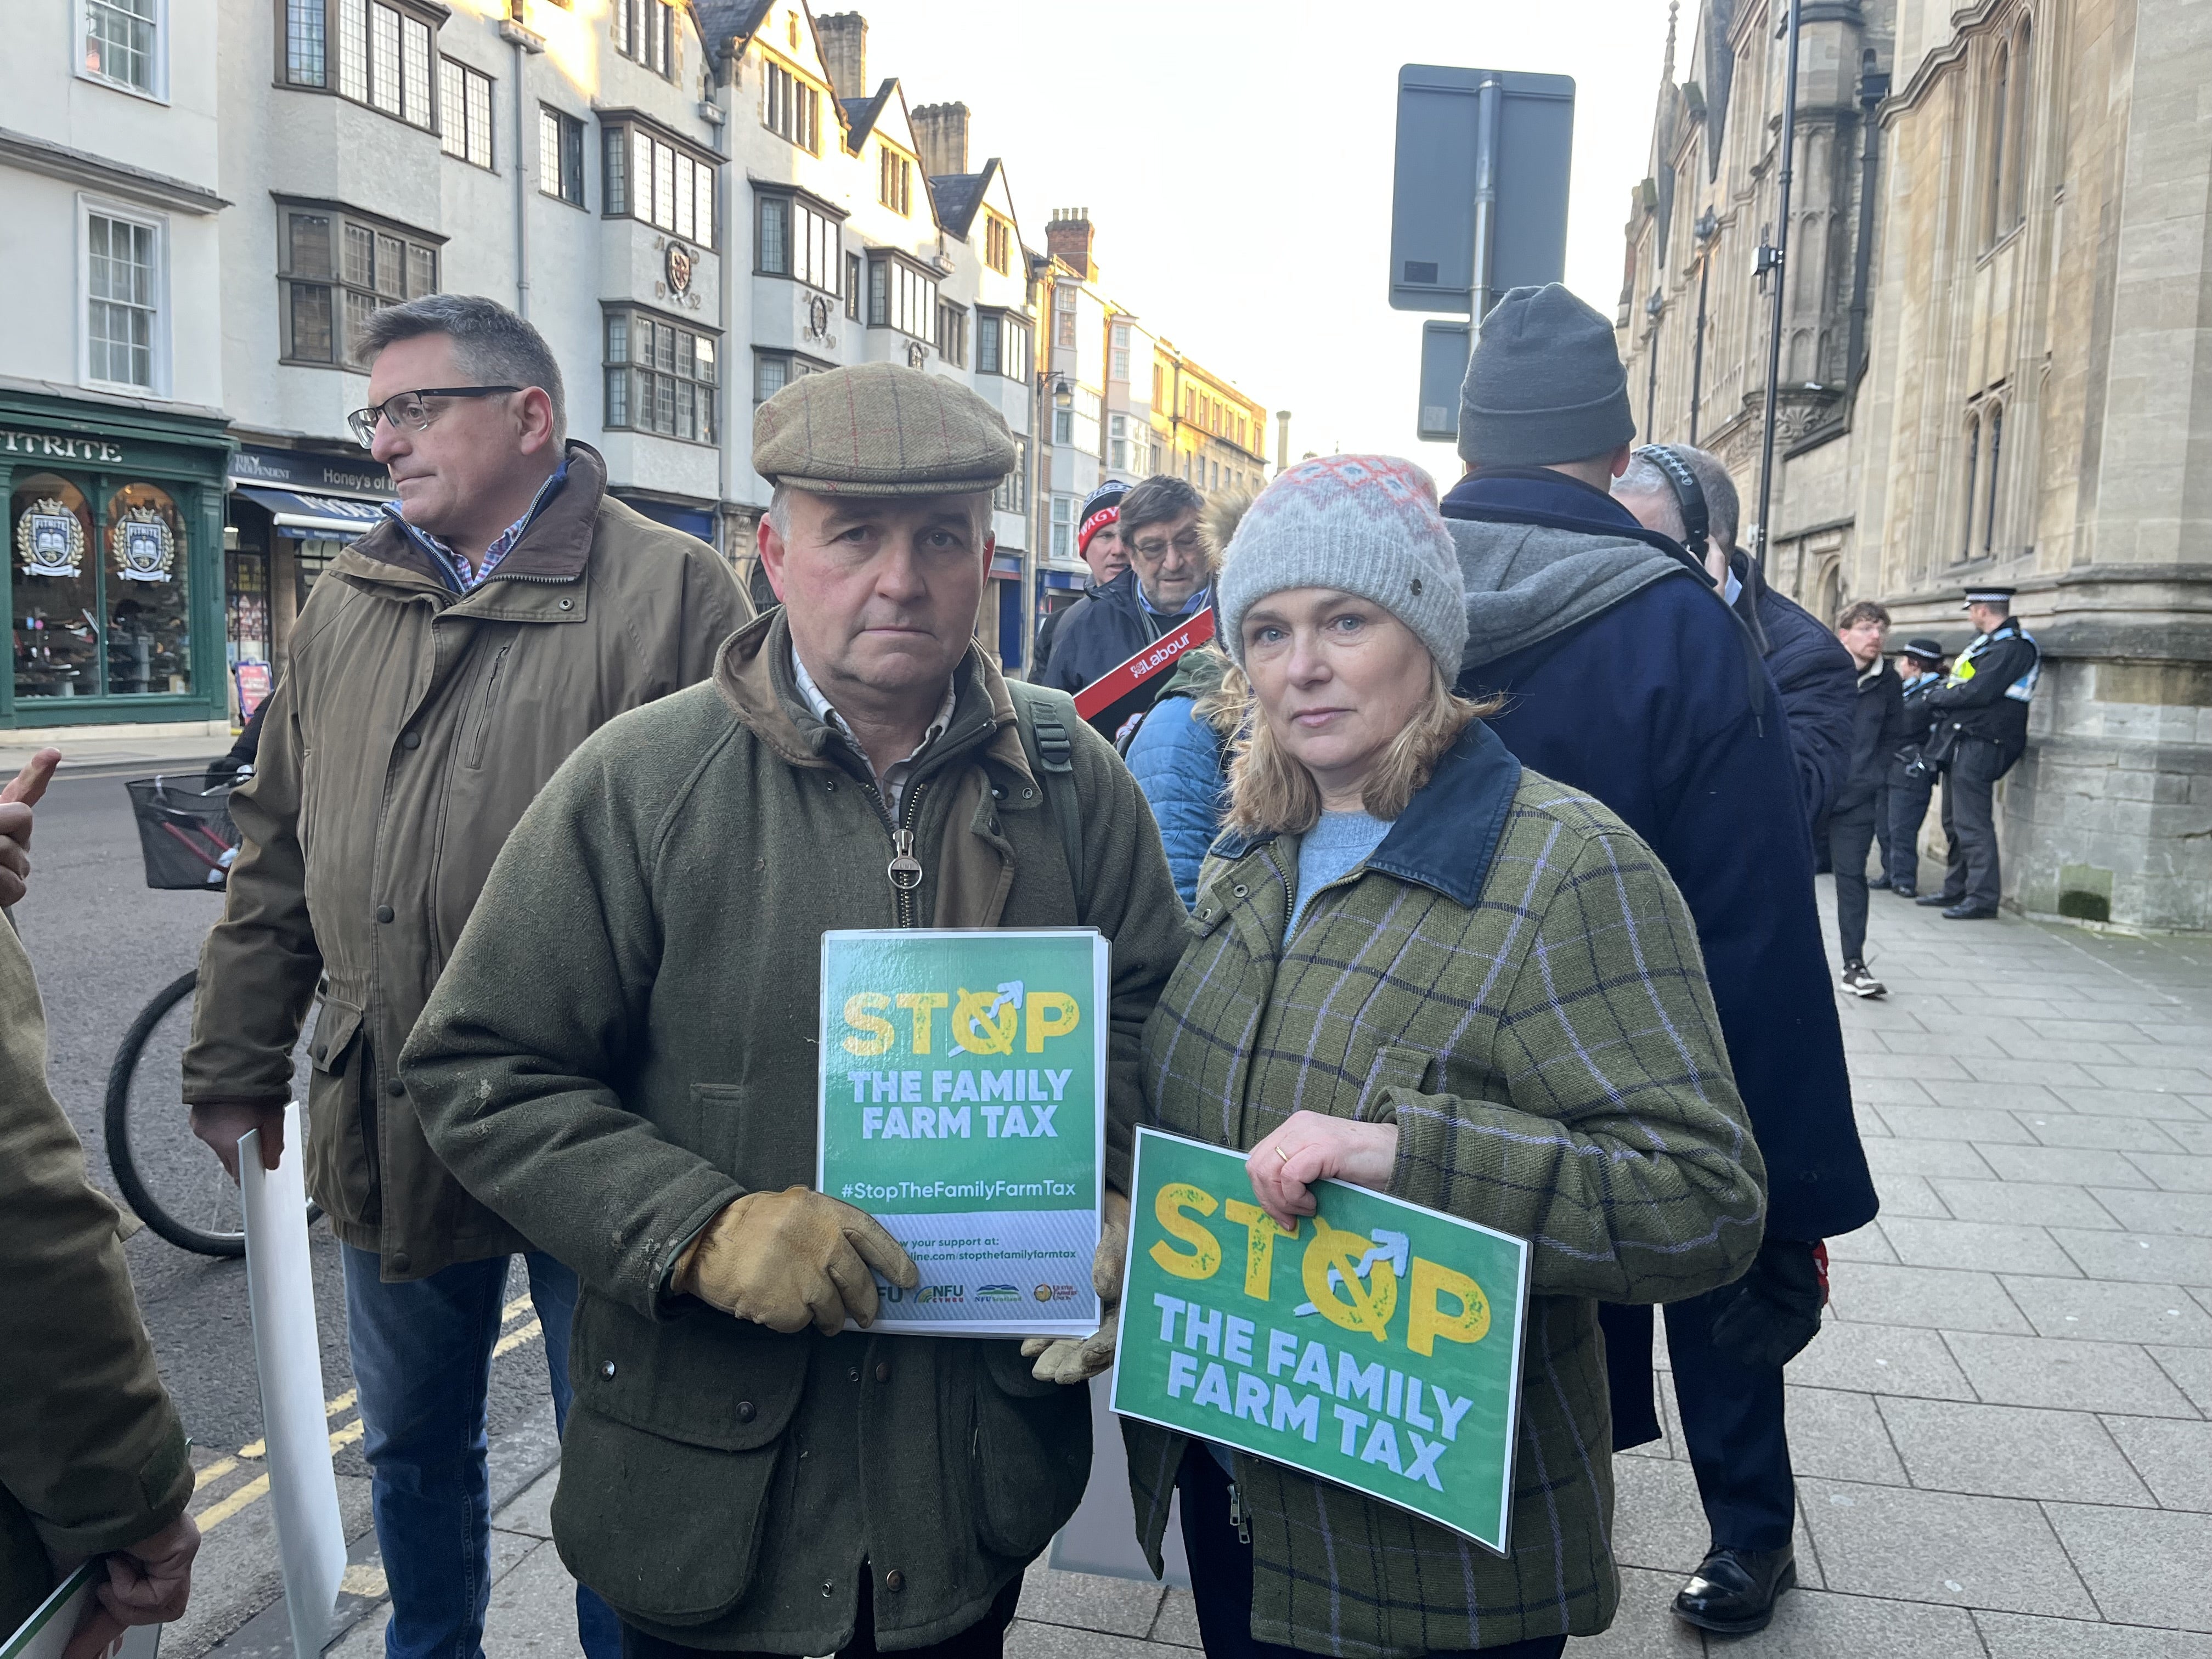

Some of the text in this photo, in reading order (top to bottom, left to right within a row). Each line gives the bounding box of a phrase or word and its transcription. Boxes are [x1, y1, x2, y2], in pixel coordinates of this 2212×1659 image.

[0, 430, 122, 462] ITRITE
[324, 468, 371, 490] Honey's
[374, 476, 385, 490] of
[1080, 506, 1120, 536] WAGY
[1141, 633, 1190, 671] Labour
[842, 988, 1080, 1056] STOP
[848, 1069, 1073, 1103] THE FAMILY
[862, 1105, 1058, 1139] FARM TAX
[842, 1180, 1076, 1202] #StopTheFamilyFarmTax
[909, 1249, 1076, 1261] line.com/stopthefamilyfarmtax
[912, 1239, 935, 1249] your
[939, 1238, 981, 1248] support
[984, 1237, 999, 1246] at:
[1149, 1182, 1491, 1357] STOP
[877, 1286, 903, 1303] FU
[933, 1285, 963, 1297] NFU
[1154, 1293, 1474, 1442] THE FAMILY
[1167, 1350, 1447, 1493] FARM TAX
